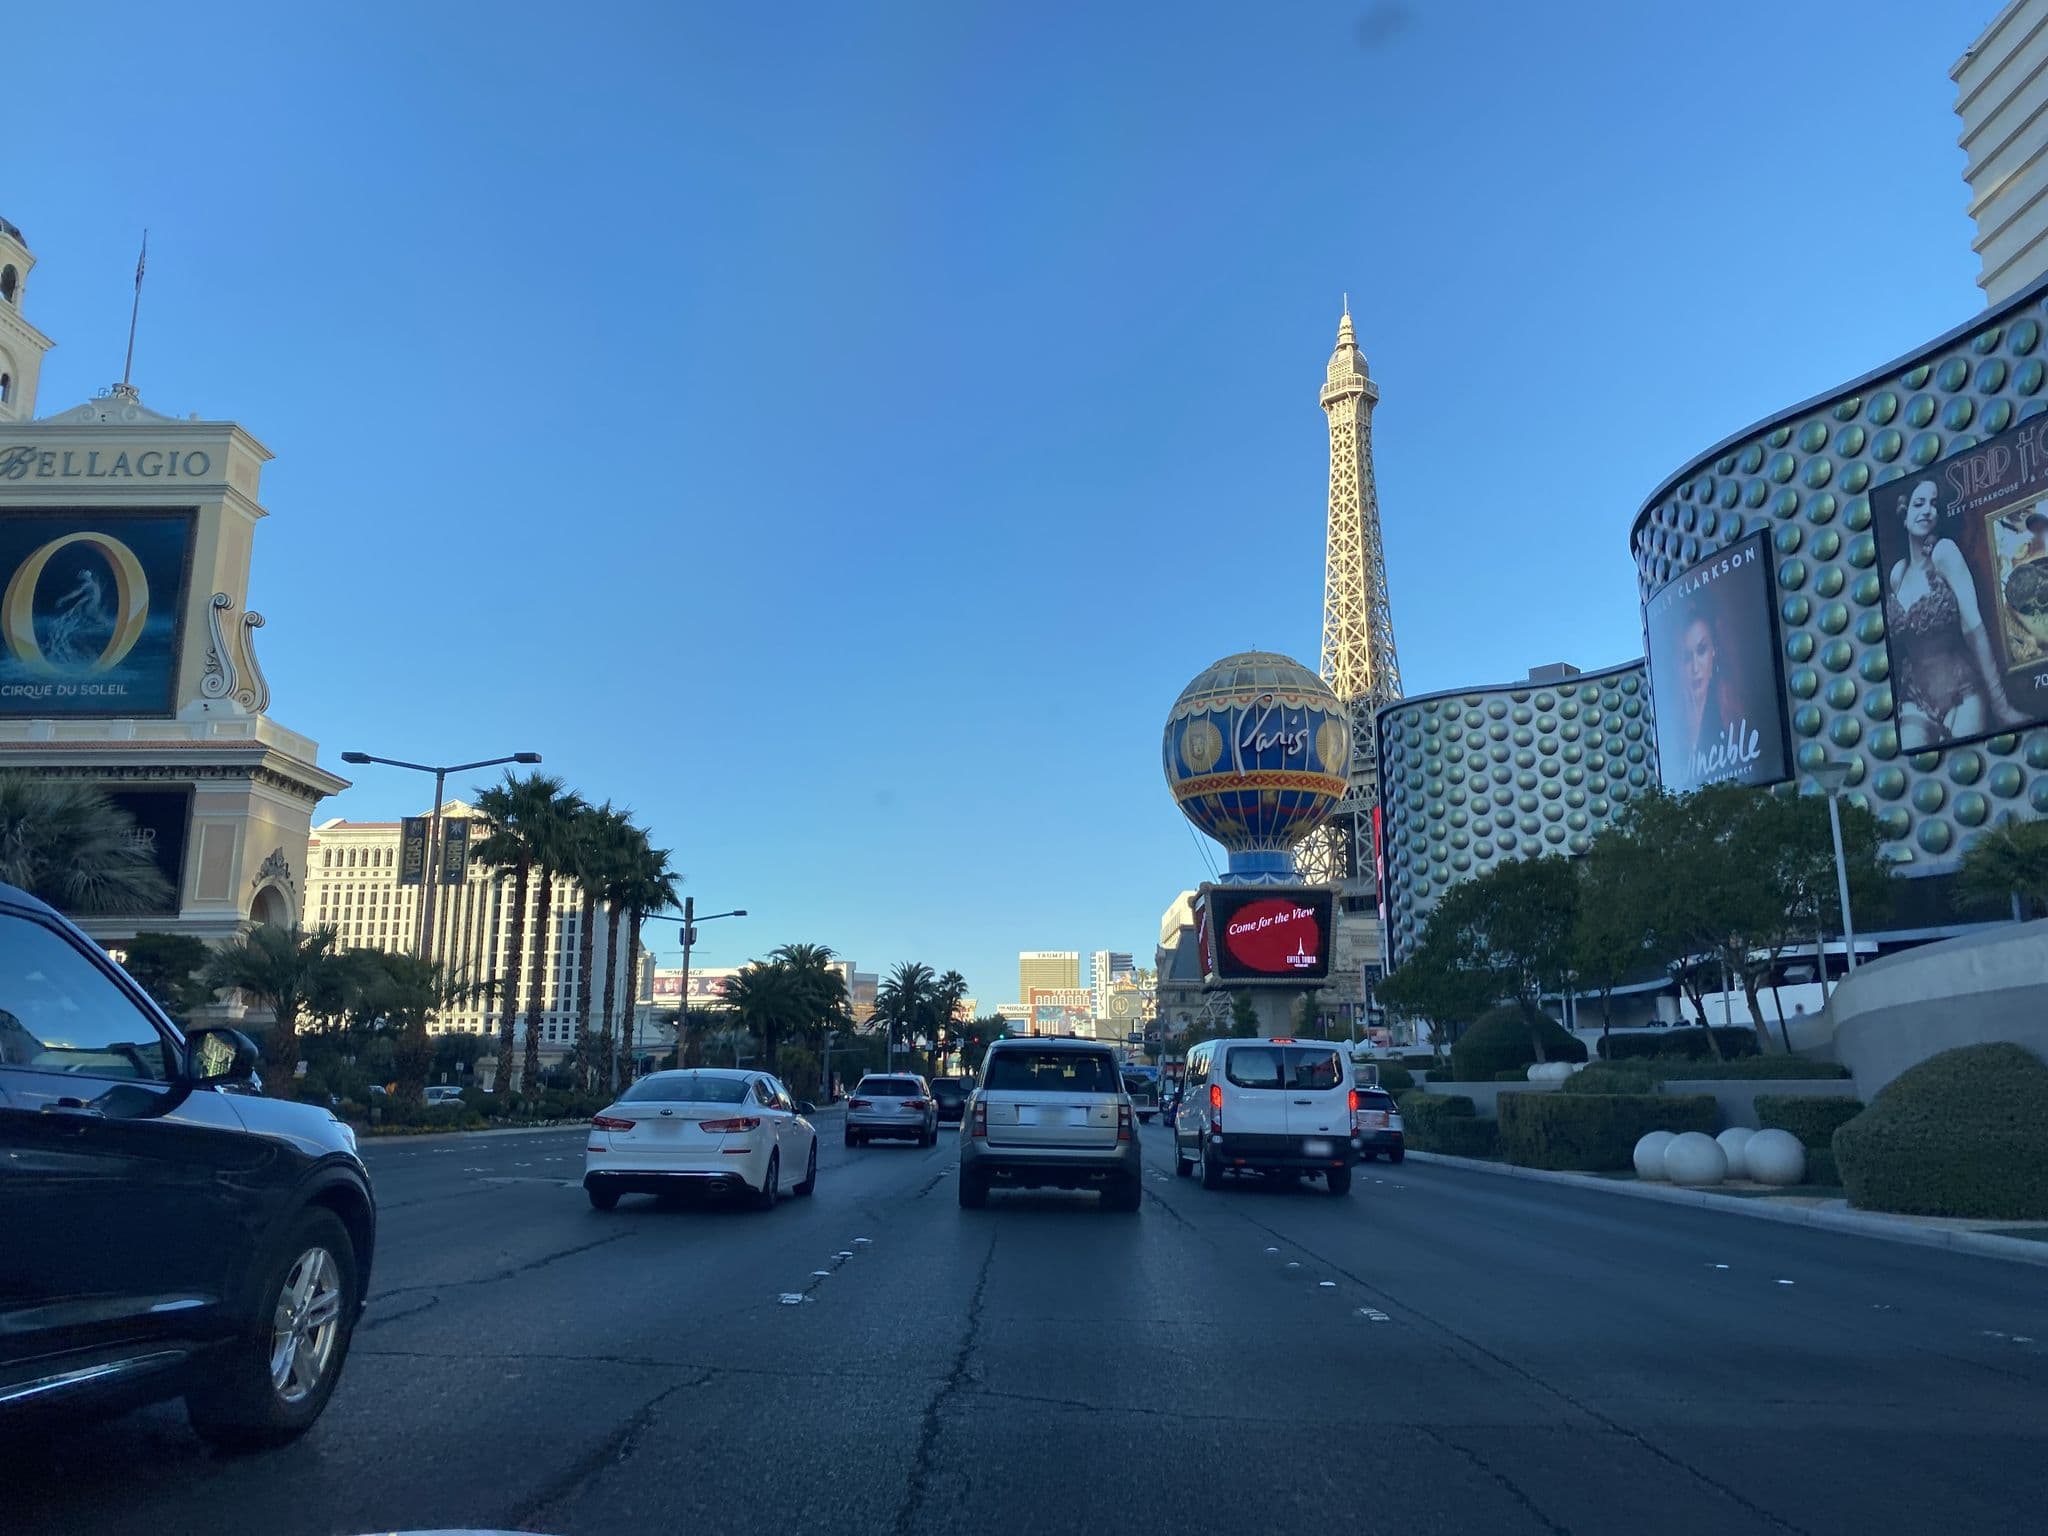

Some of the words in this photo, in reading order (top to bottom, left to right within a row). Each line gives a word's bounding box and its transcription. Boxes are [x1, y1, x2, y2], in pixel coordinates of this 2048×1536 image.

[0, 446, 211, 480] BELLAGIO
[1945, 445, 2011, 511] STRIP
[1946, 503, 1967, 518] SEXY
[1969, 482, 2019, 509] STEAKHOUSE
[1678, 546, 1756, 598] CLARKSON
[1, 684, 53, 699] CIRQUE
[56, 684, 77, 696] DU
[80, 684, 128, 696] SOLEIL
[1235, 692, 1310, 777] Paris
[406, 837, 423, 875] VEGAS
[447, 840, 463, 871] BORN
[1229, 921, 1257, 936] Come
[1256, 916, 1273, 932] for
[1274, 912, 1290, 925] the
[1292, 906, 1315, 920] View
